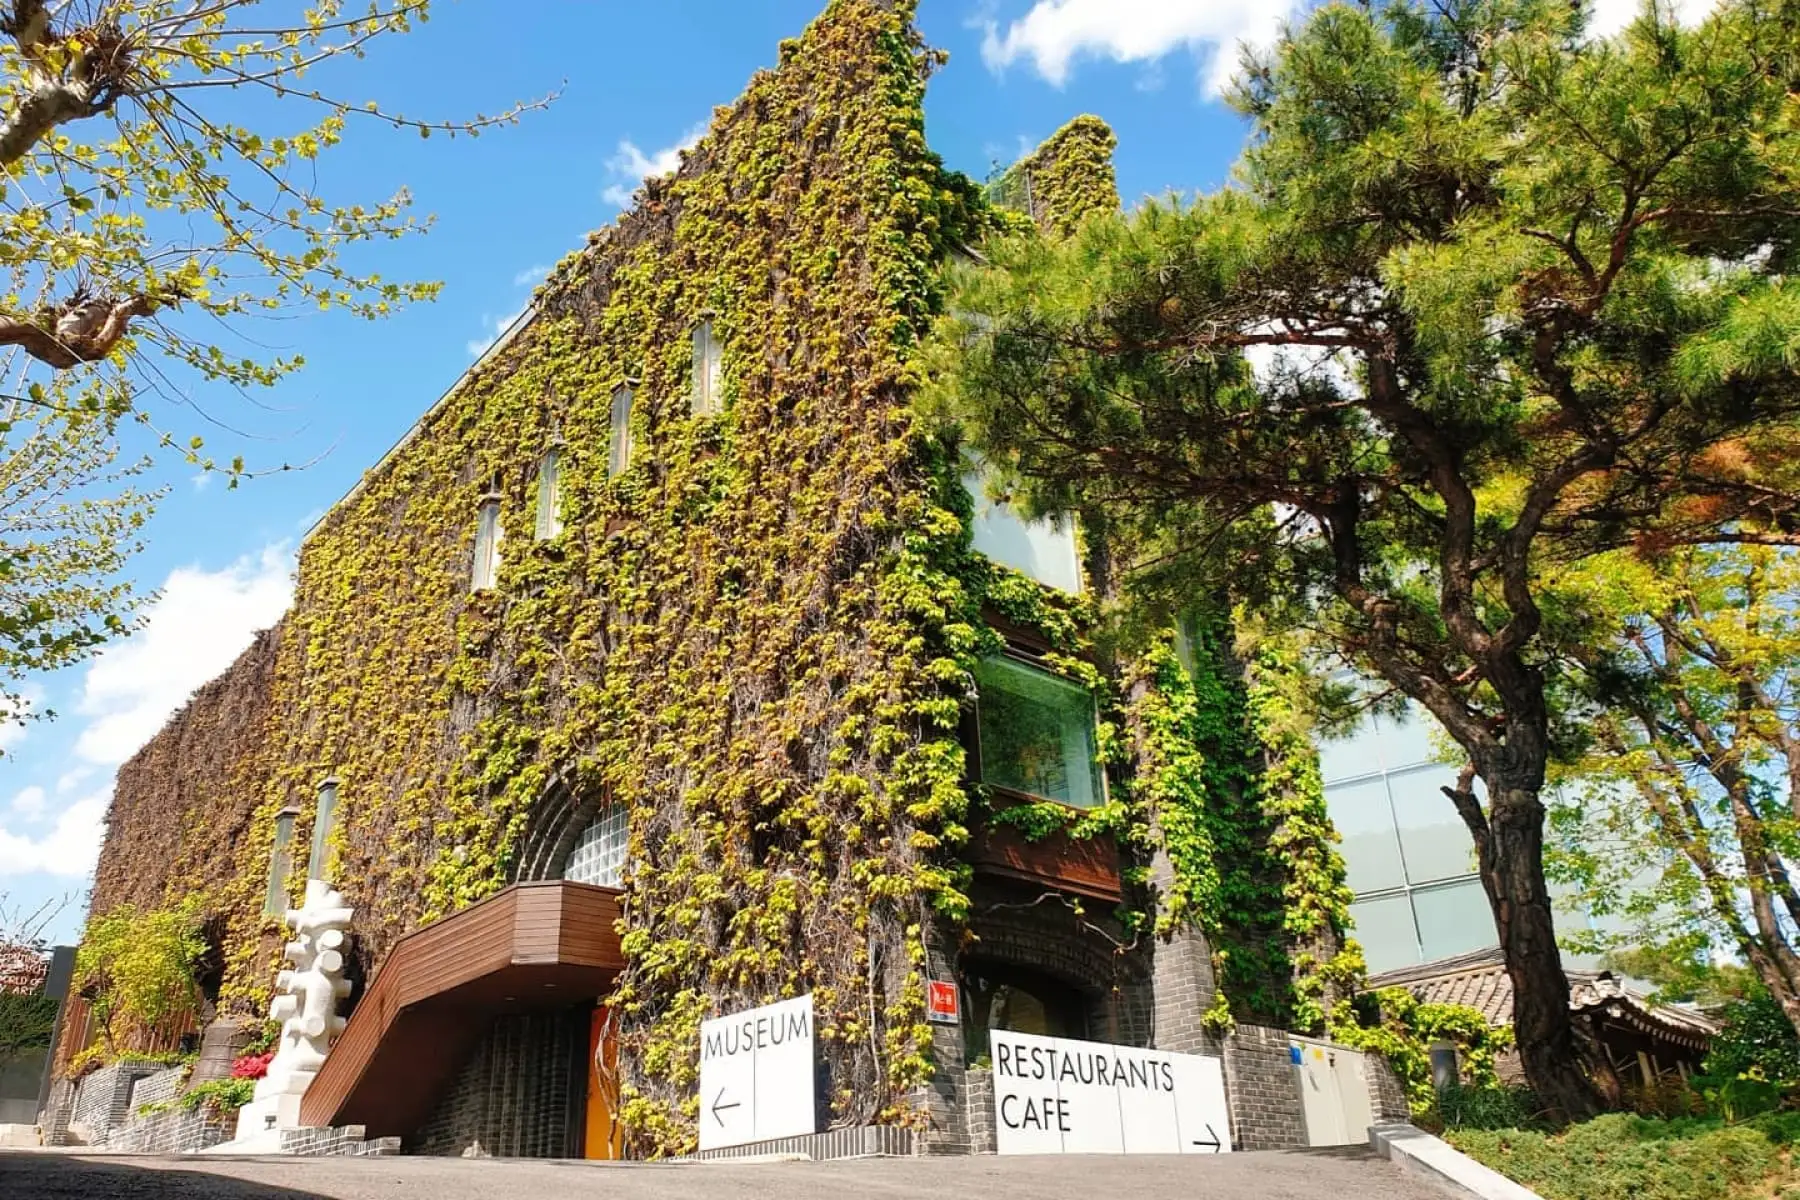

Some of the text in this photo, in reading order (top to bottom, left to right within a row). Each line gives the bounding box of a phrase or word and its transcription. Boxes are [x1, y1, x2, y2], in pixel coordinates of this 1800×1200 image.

[704, 1008, 809, 1061] MUSEUM
[997, 1042, 1174, 1092] RESTAURANTS
[1000, 1094, 1072, 1132] CAFE
